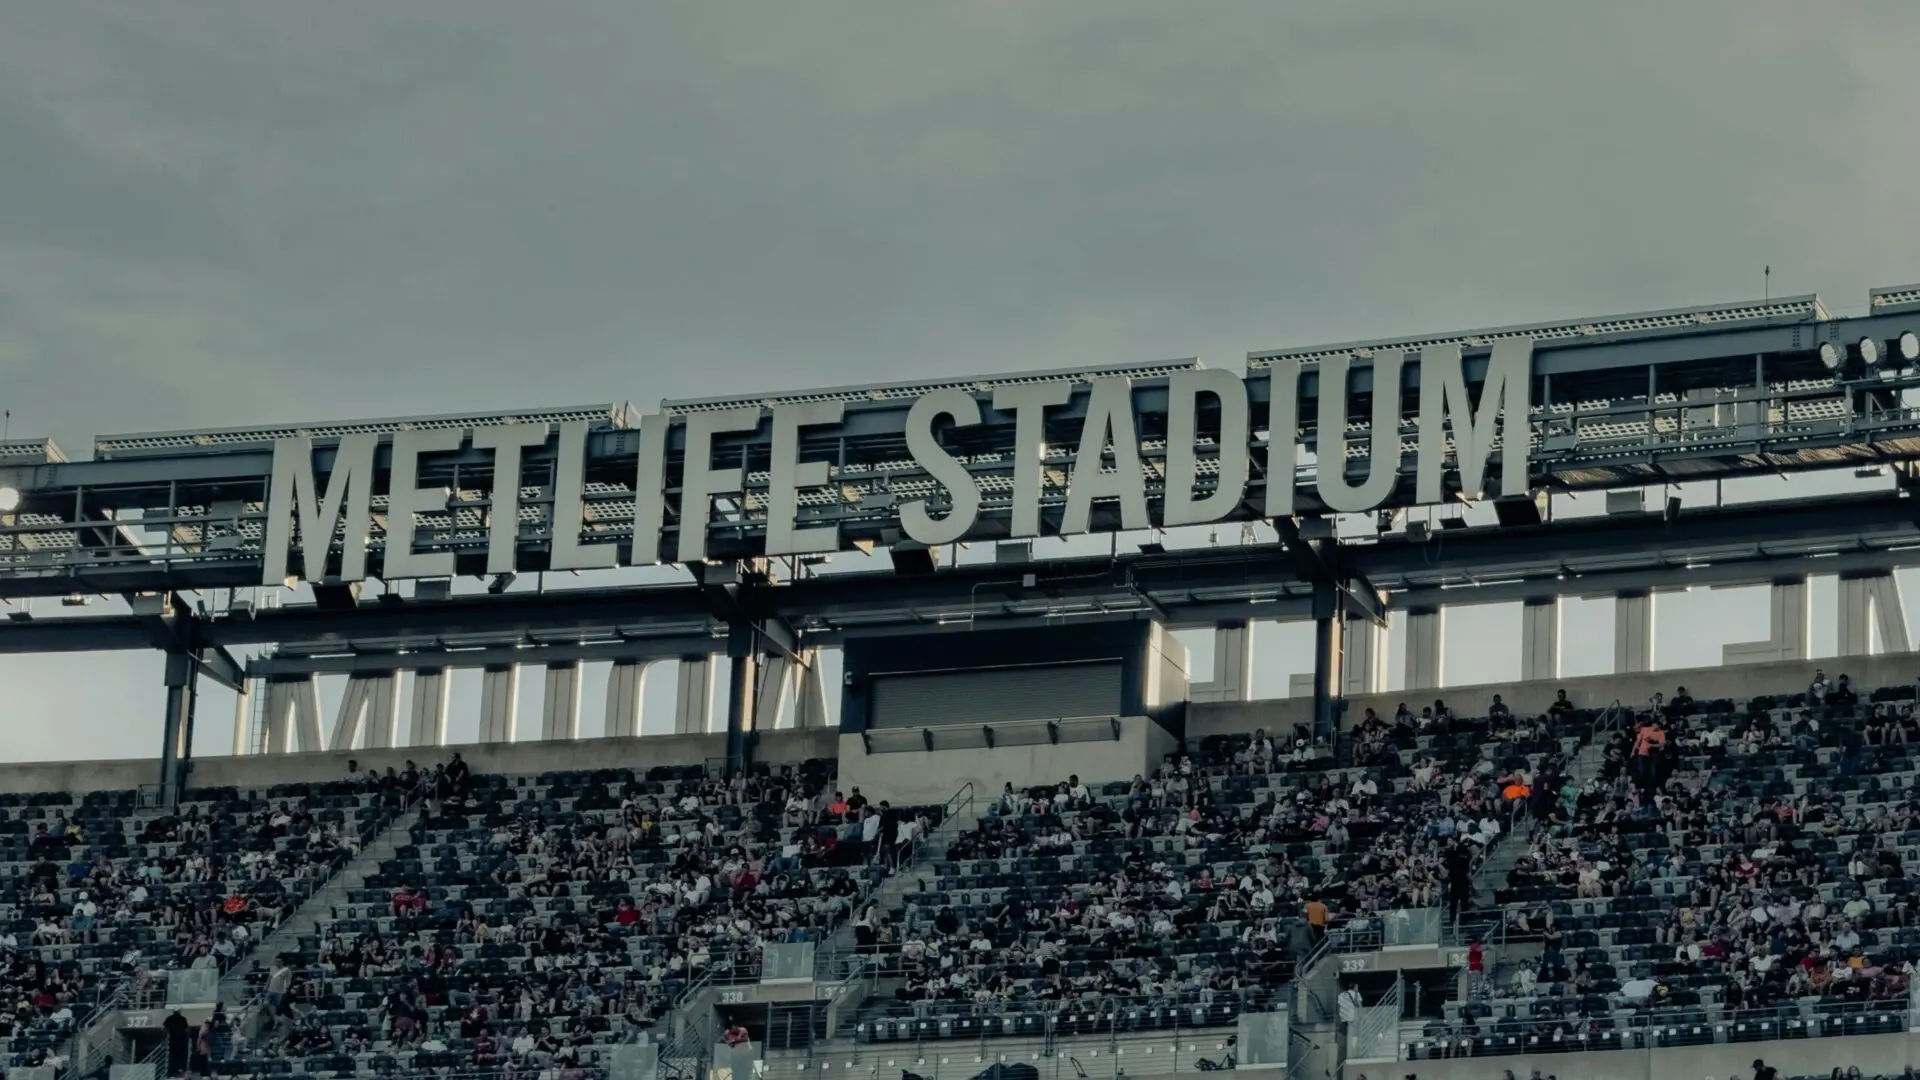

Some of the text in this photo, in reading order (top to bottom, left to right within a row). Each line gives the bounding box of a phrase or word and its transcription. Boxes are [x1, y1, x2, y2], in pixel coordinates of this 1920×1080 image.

[262, 338, 1534, 587] METLIFE STADIUM
[1342, 958, 1365, 972] 339
[127, 1015, 148, 1027] 337
